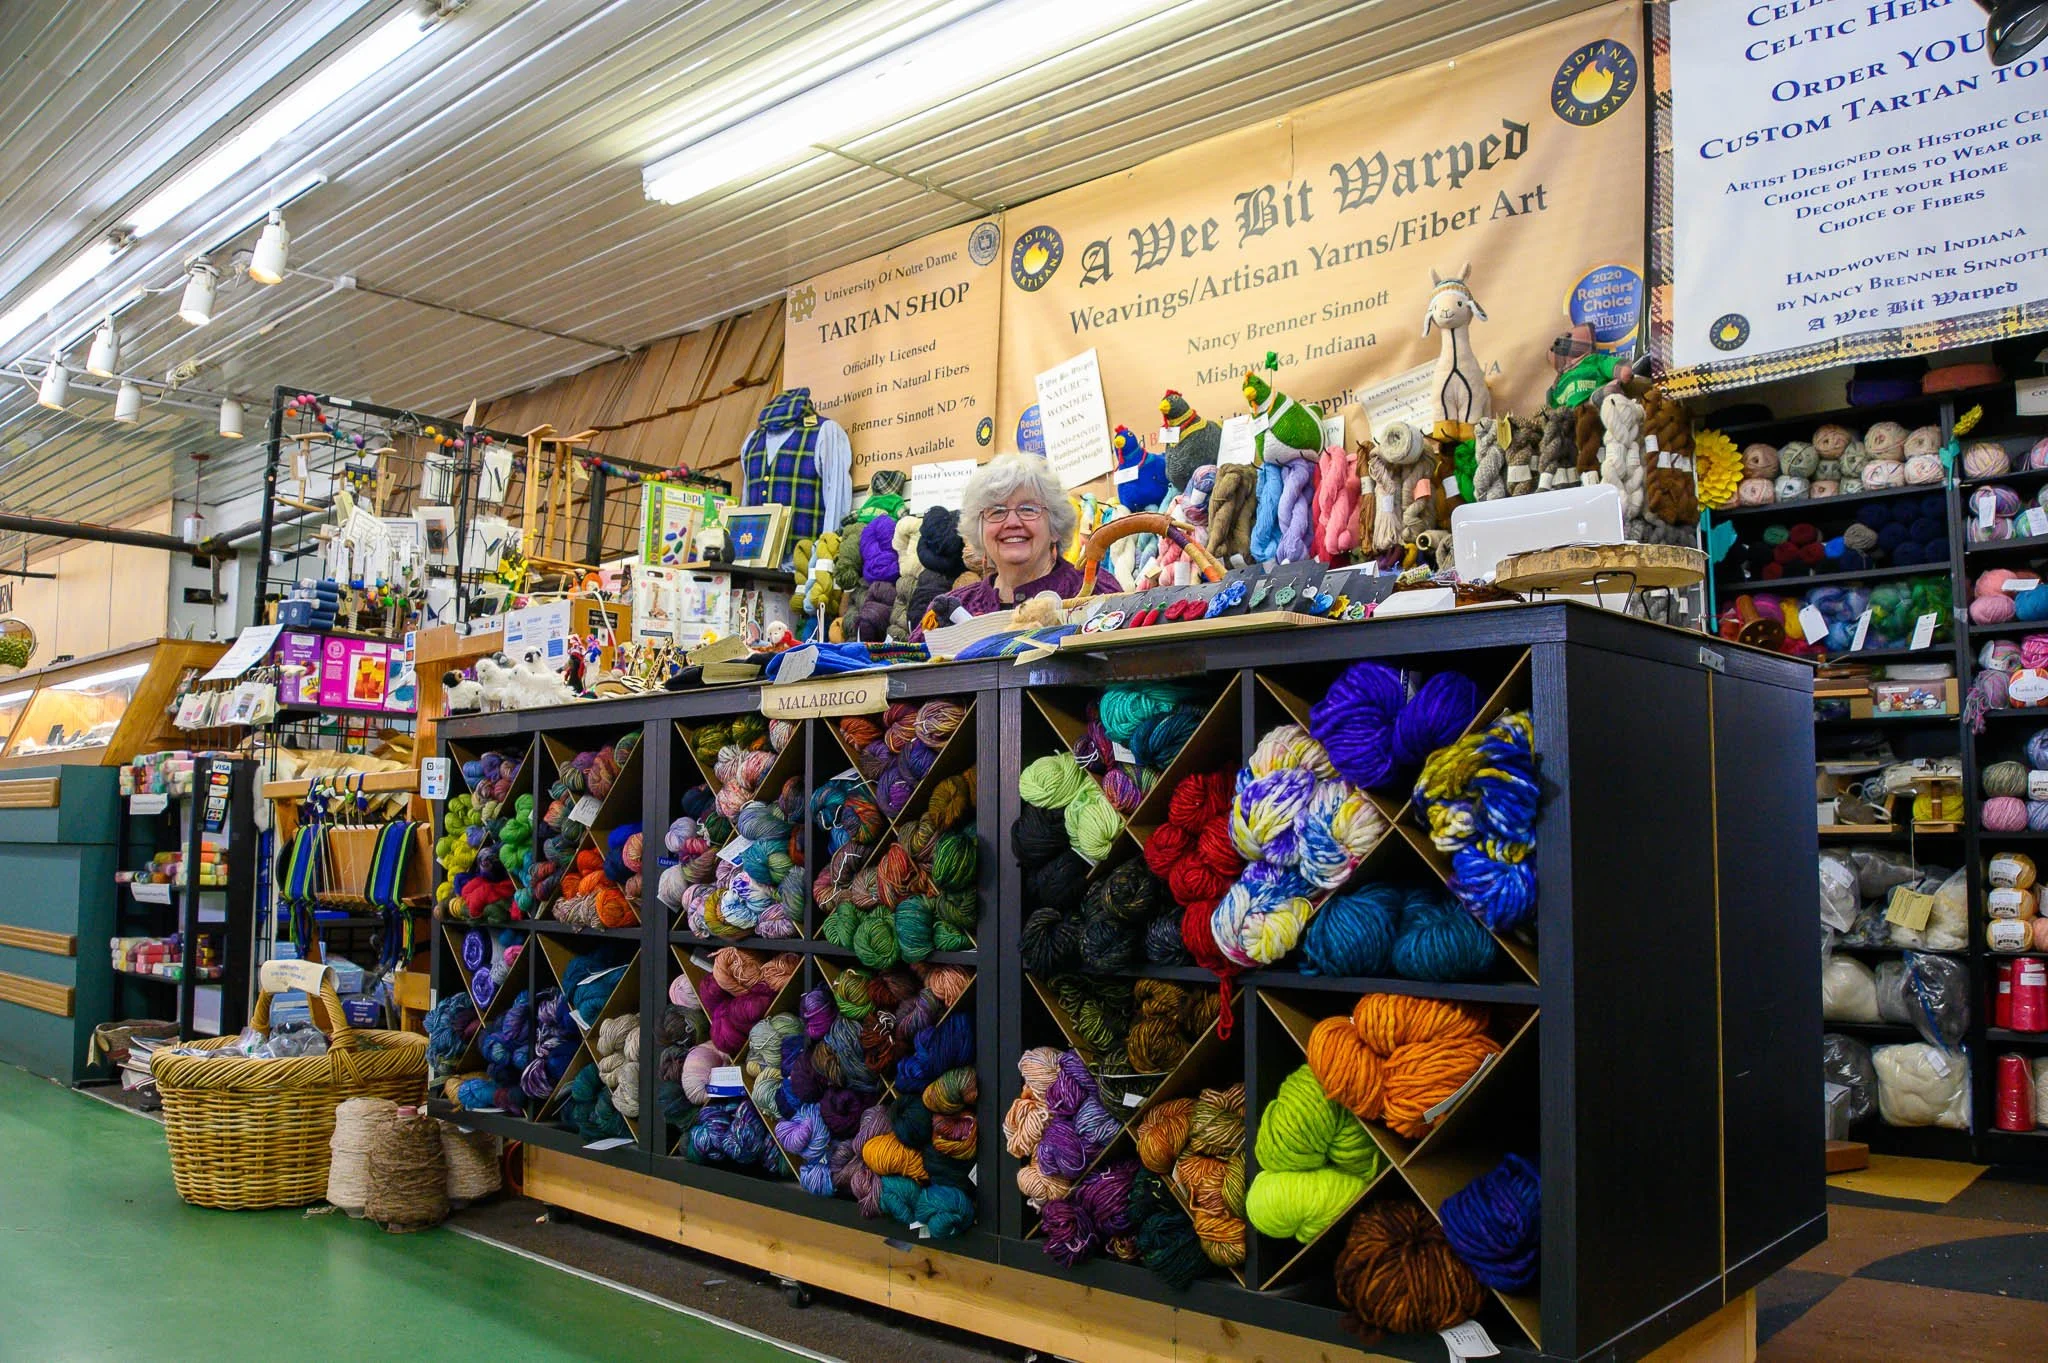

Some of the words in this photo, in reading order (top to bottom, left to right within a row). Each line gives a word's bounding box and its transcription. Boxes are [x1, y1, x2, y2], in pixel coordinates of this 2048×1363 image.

[1745, 19, 1856, 62] CELTIC
[1558, 44, 1628, 85] INDIANA
[1771, 62, 1889, 103] ORDER
[1557, 80, 1630, 121] ARTISAN
[1699, 115, 1832, 160] CUSTOM
[1842, 75, 1980, 123] TARTAN
[1726, 175, 1787, 194] ARTIST
[1792, 150, 1881, 181] DESIGNED
[1887, 143, 1912, 157] OR
[1917, 118, 2009, 149] HISTORIC
[1763, 183, 1831, 207] CHOICE
[1836, 175, 1857, 190] OF
[1863, 163, 1917, 181] ITEMS
[1923, 156, 1946, 169] TO
[1952, 138, 2009, 161] WEAR
[2015, 132, 2043, 146] OR
[1079, 236, 1114, 288] A
[1129, 217, 1219, 274] Wee
[1234, 179, 1314, 248] Bit
[1329, 117, 1531, 214] Warped
[1795, 188, 1889, 219] DECORATE
[1895, 178, 1944, 194] YOUR
[1949, 161, 2009, 184] HOME
[1819, 209, 1887, 234] CHOICE
[1892, 202, 1916, 216] OF
[1922, 189, 1985, 211] FIBERS
[1014, 230, 1060, 259] INDIANA
[1069, 257, 1299, 335] Weavings/Artisan
[1308, 202, 1482, 273] Yarns/Fiber
[1489, 182, 1549, 221] Art
[1786, 248, 1910, 286] HAND-WOVEN
[1916, 245, 1937, 257] IN
[1944, 227, 2027, 253] INDIANA
[824, 277, 877, 302] University
[878, 270, 893, 285] Of
[895, 262, 924, 279] Notre
[926, 250, 958, 269] Dame
[1014, 258, 1059, 288] ARTISAN
[1592, 270, 1622, 284] 2020
[1777, 300, 1797, 312] BY
[1802, 283, 1864, 307] NANCY
[1869, 265, 1958, 291] BRENNER
[818, 301, 900, 344] TARTAN
[906, 282, 970, 317] SHOP
[1187, 331, 1241, 354] Nancy
[1247, 312, 1317, 341] Brenner
[1321, 289, 1390, 321] Sinnott
[1583, 295, 1633, 312] Choice
[1808, 317, 1826, 331] A
[1833, 305, 1880, 325] Wee
[1887, 296, 1925, 316] Bit
[1931, 280, 2019, 306] Warped
[843, 353, 886, 376] Officially
[890, 341, 936, 362] Licensed
[1196, 351, 1300, 387] Mishawka,
[1305, 331, 1377, 361] Indiana
[814, 387, 873, 411] Hand-Woven
[876, 382, 888, 393] in
[892, 369, 931, 391] Natural
[935, 363, 970, 381] Fibers
[851, 416, 893, 435] Brenner
[896, 406, 934, 425] Sinnott
[937, 399, 957, 414] ND
[1060, 414, 1085, 429] YARN
[855, 448, 903, 467] Options
[905, 436, 955, 458] Available
[778, 689, 868, 711] MALABRIGO
[214, 763, 230, 771] VISA
